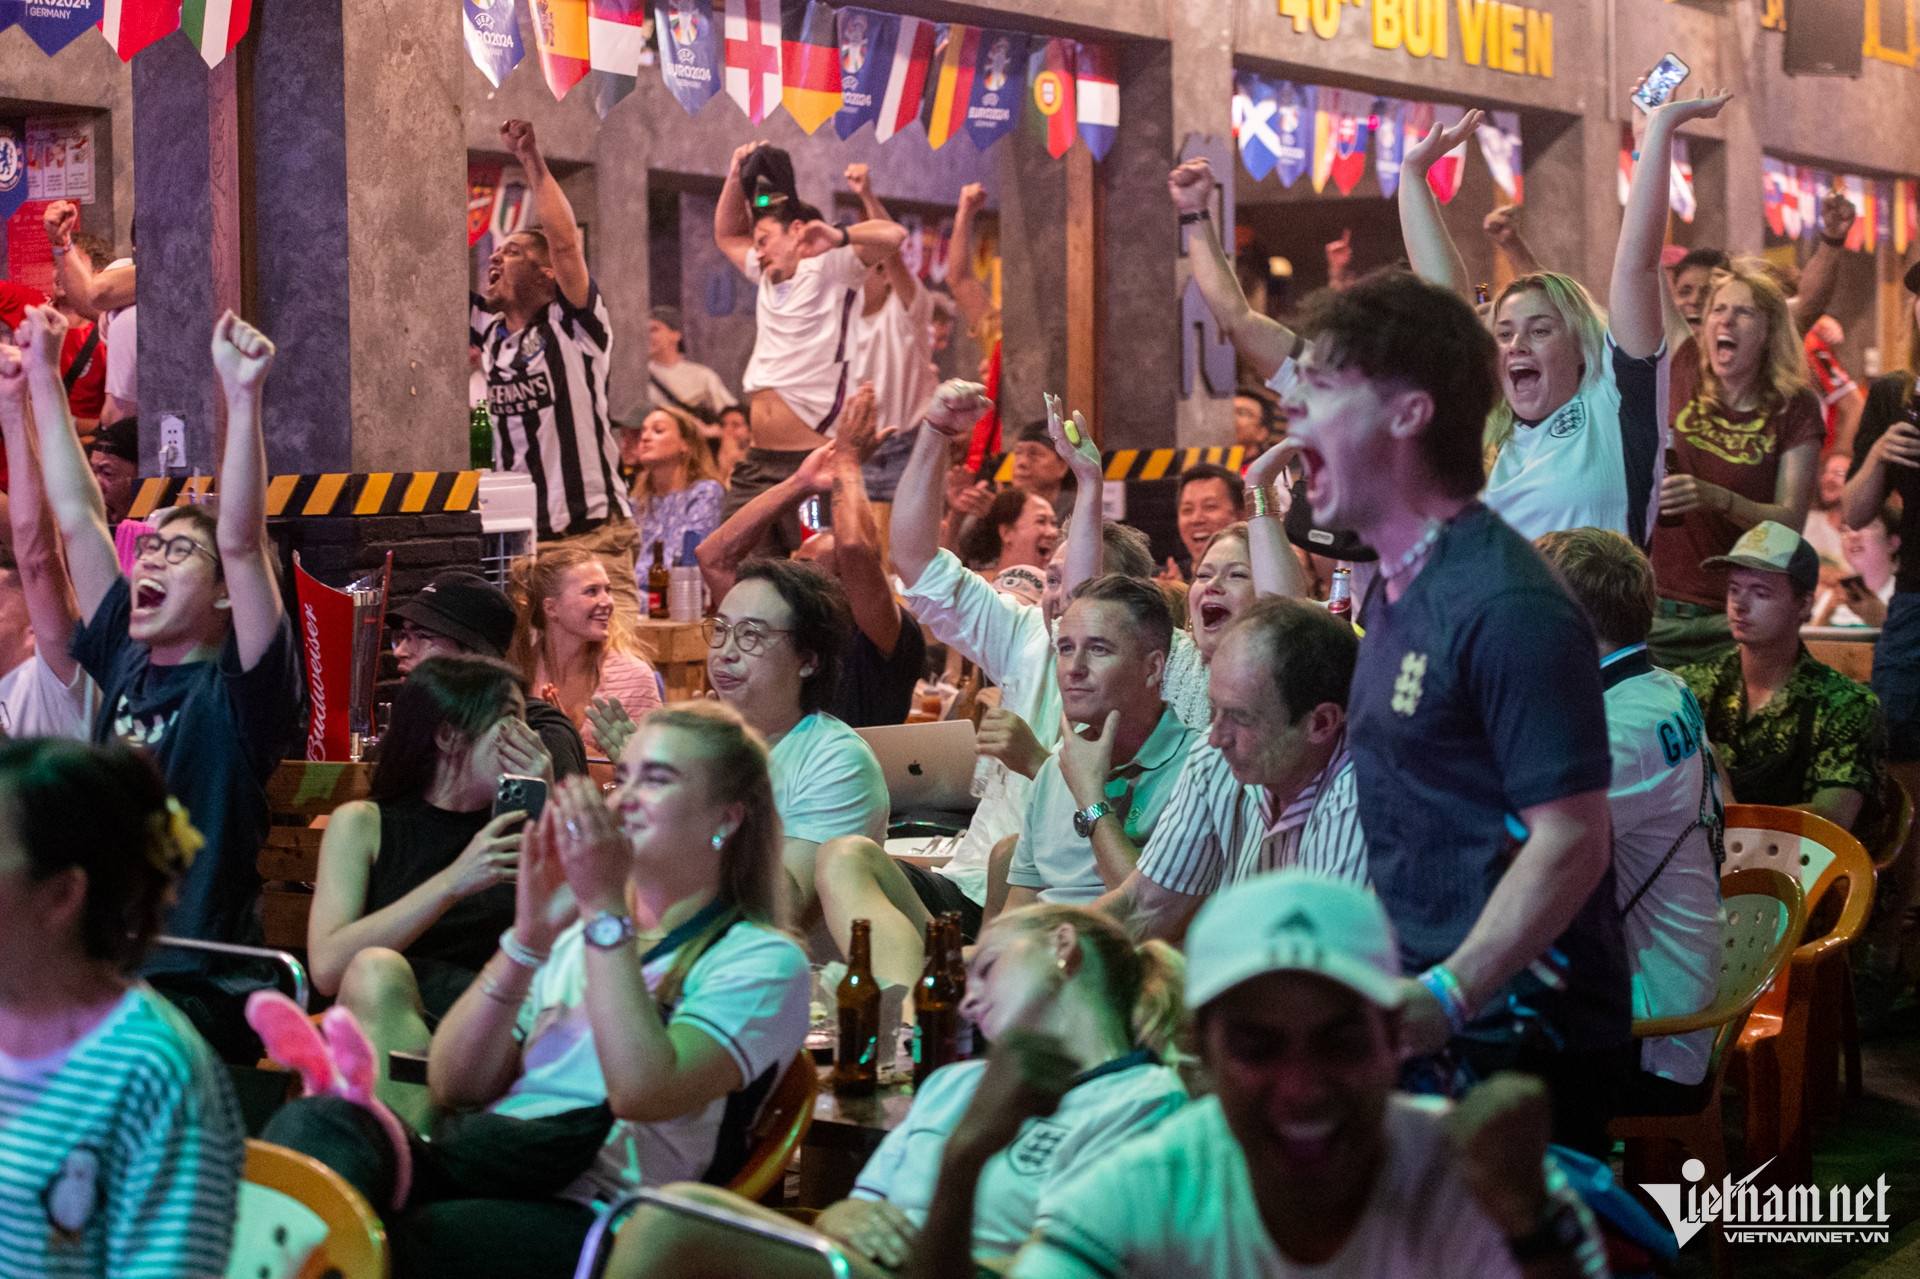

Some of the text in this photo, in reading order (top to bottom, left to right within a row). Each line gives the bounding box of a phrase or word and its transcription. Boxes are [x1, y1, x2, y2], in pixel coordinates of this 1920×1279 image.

[29, 7, 71, 19] GERMANY
[475, 13, 496, 31] UEFA
[1457, 0, 1553, 78] VIEN
[306, 603, 327, 762] Budweiser
